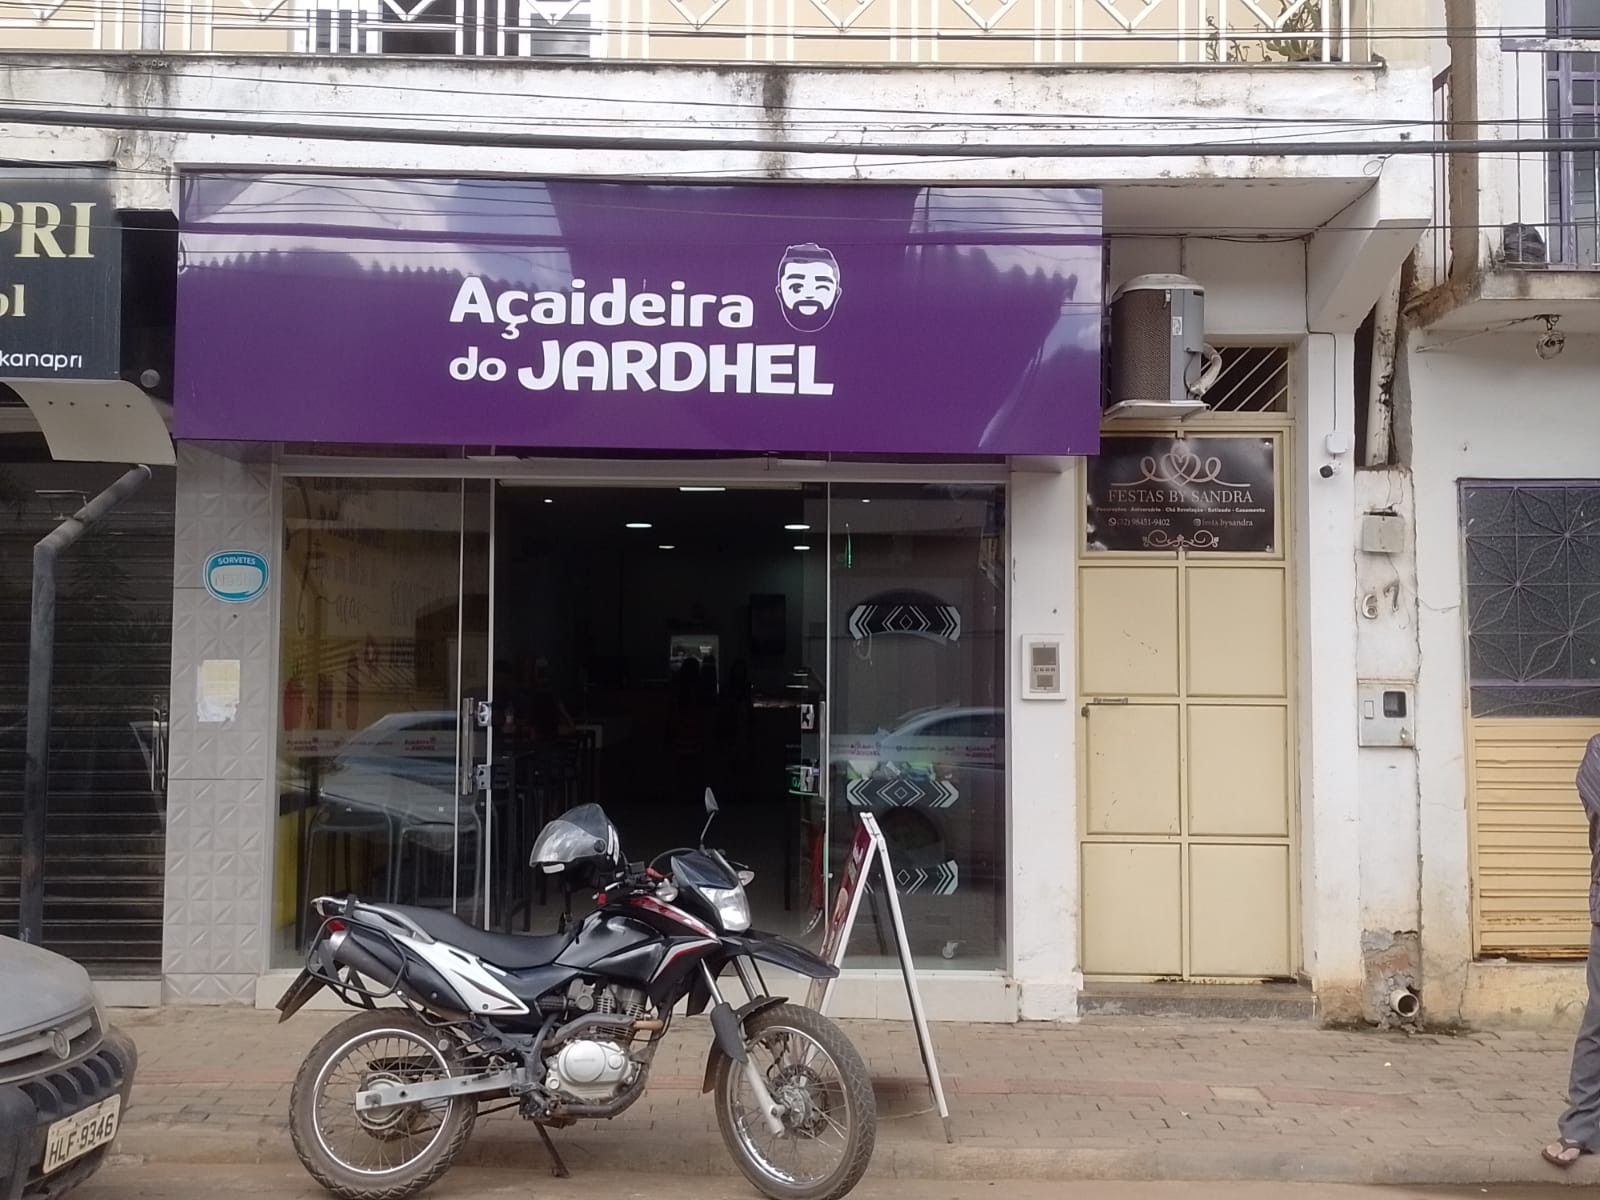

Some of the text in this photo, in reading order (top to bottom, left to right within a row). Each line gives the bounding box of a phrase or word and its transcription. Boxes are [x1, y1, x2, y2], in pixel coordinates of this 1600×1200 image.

[449, 275, 754, 340] Açaideira
[448, 339, 834, 396] do JARDHEL
[1108, 489, 1253, 503] FESTAS BY SANDRA
[217, 556, 256, 566] SORVETES
[1361, 582, 1400, 620] 67
